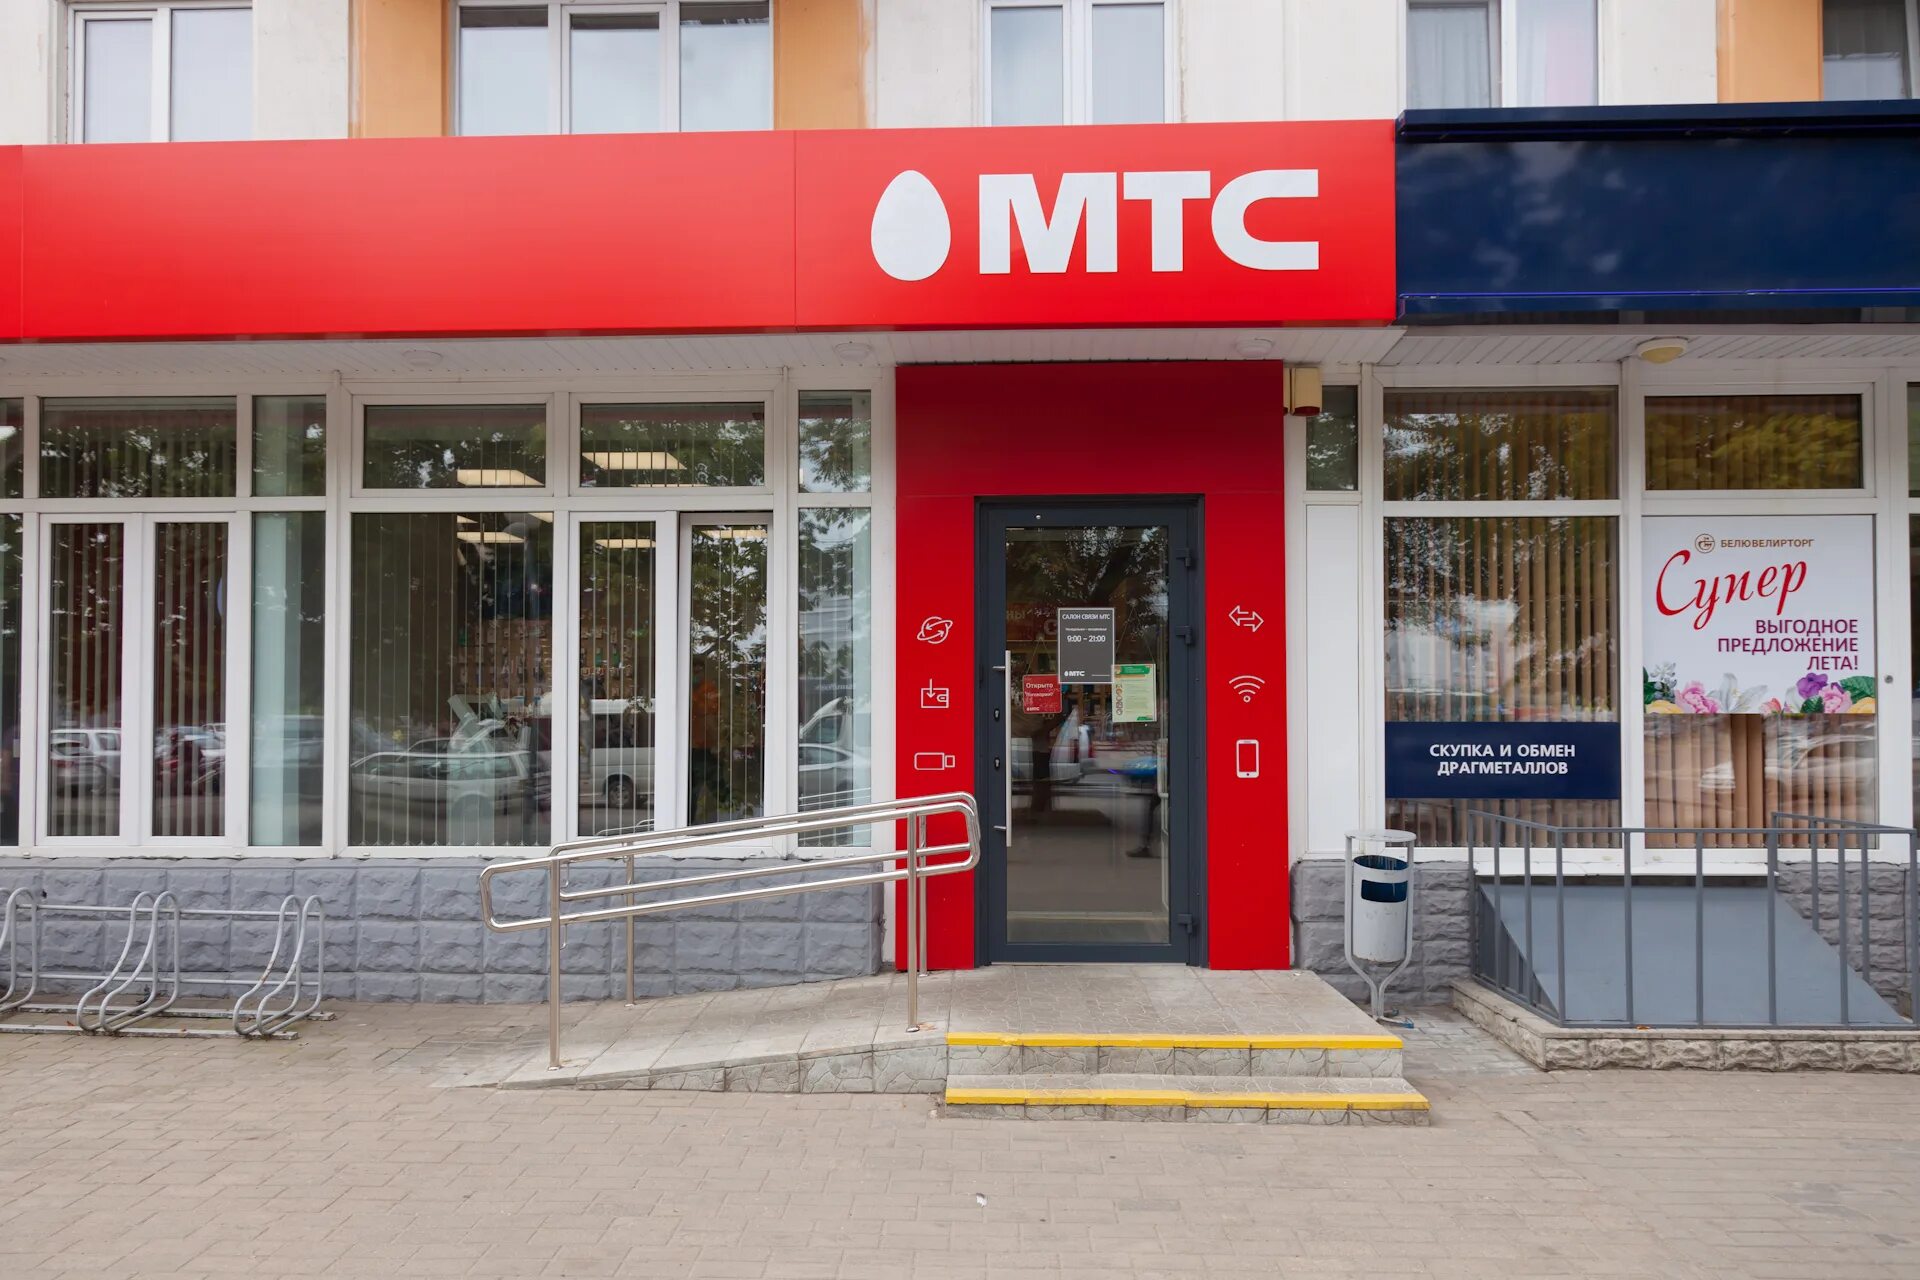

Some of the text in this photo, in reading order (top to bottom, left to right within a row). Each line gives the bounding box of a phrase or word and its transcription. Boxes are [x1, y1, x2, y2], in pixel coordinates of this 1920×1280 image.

[979, 168, 1319, 274] МТС
[1720, 538, 1814, 549] БЕЛЮВЕЛИРТОРГ
[1655, 549, 1808, 631] Супер
[1755, 619, 1858, 637] ВЫГОДНОЕ
[1717, 637, 1859, 655] ПРЕДЛОЖЕНИЕ
[1806, 655, 1859, 671] ЛЕТА!
[1429, 744, 1576, 757] СКУПКА И ОБМЕН
[1437, 761, 1569, 776] ДРАГМЕТАЛЛОВ
